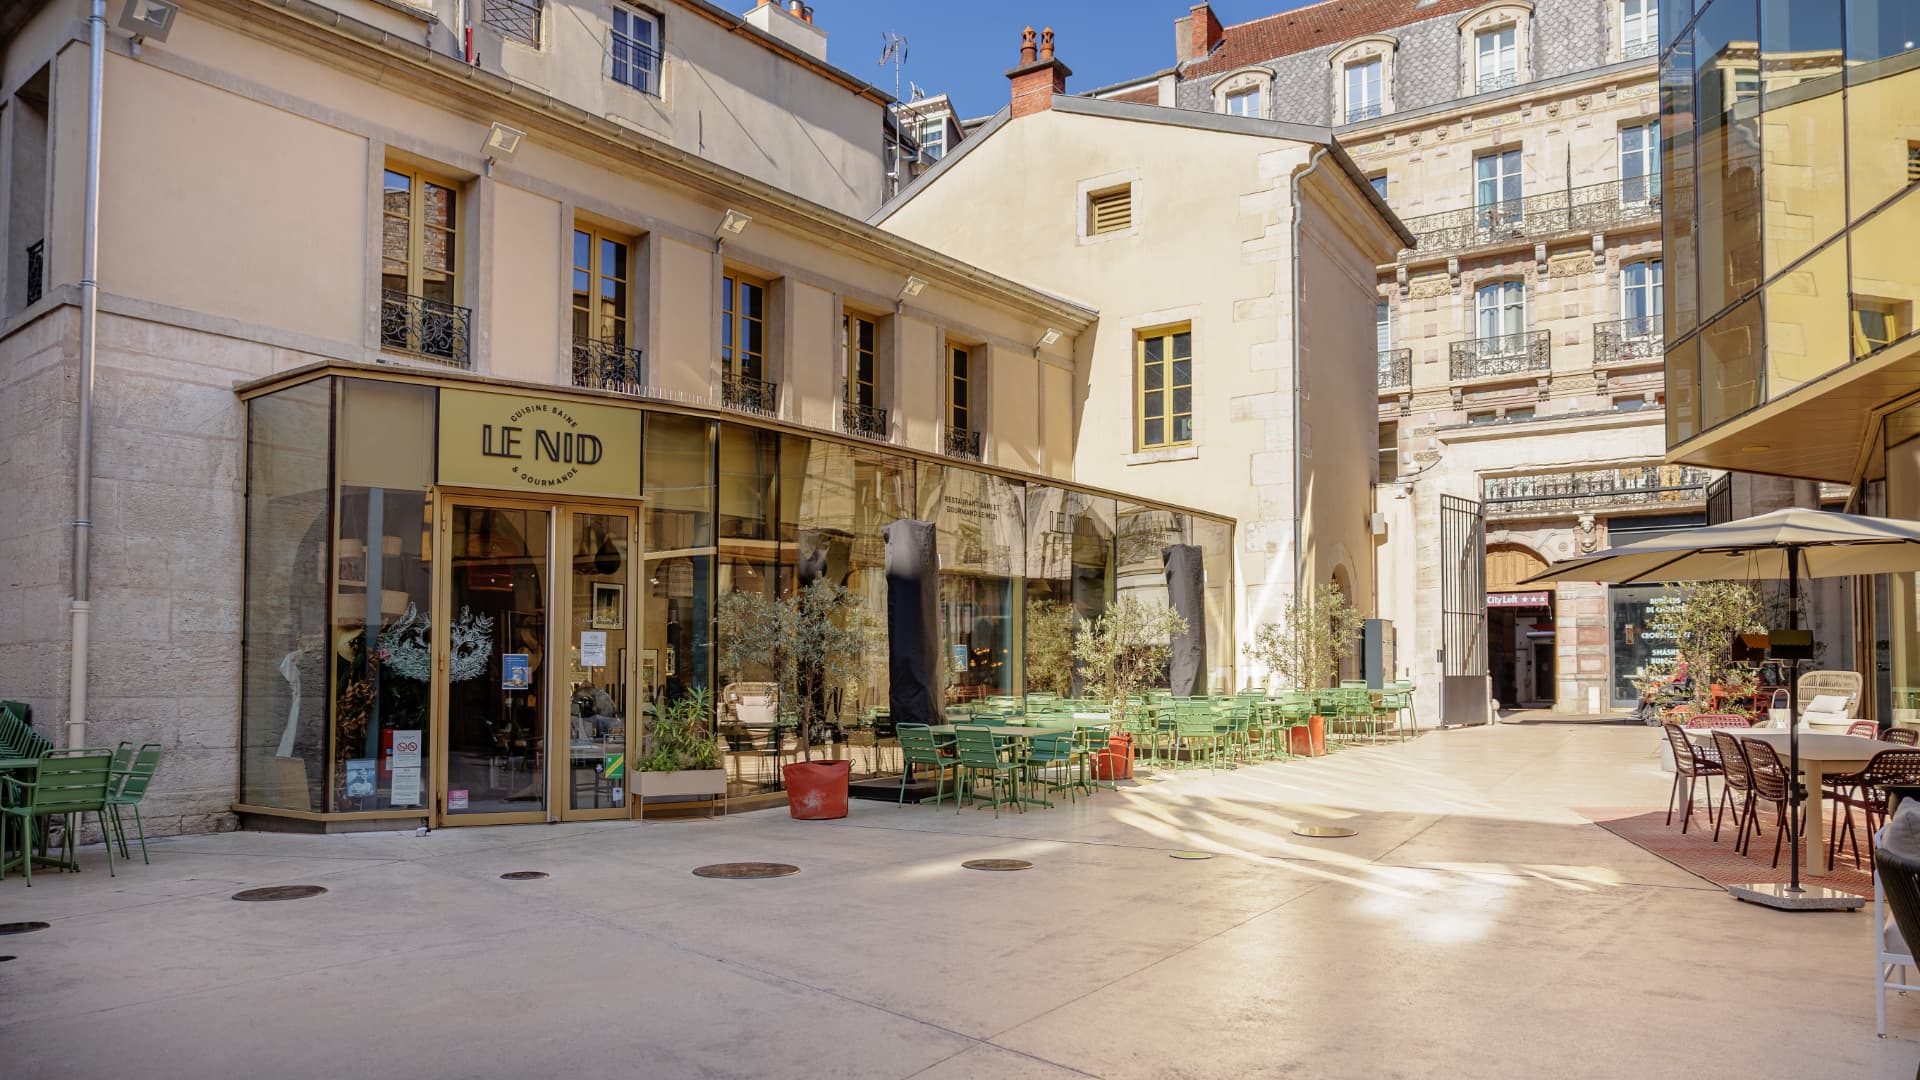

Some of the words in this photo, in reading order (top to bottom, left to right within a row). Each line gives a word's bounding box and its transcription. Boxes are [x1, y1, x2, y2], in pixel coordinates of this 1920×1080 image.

[510, 404, 548, 422] CUISINE
[552, 407, 578, 428] SAINE
[482, 424, 523, 459] LE
[535, 429, 603, 465] NID
[521, 467, 578, 487] GOURMANDE
[944, 495, 978, 507] RESTAURANT
[946, 505, 977, 517] GOURMAND
[1487, 596, 1502, 605] City
[1503, 594, 1517, 604] Loft
